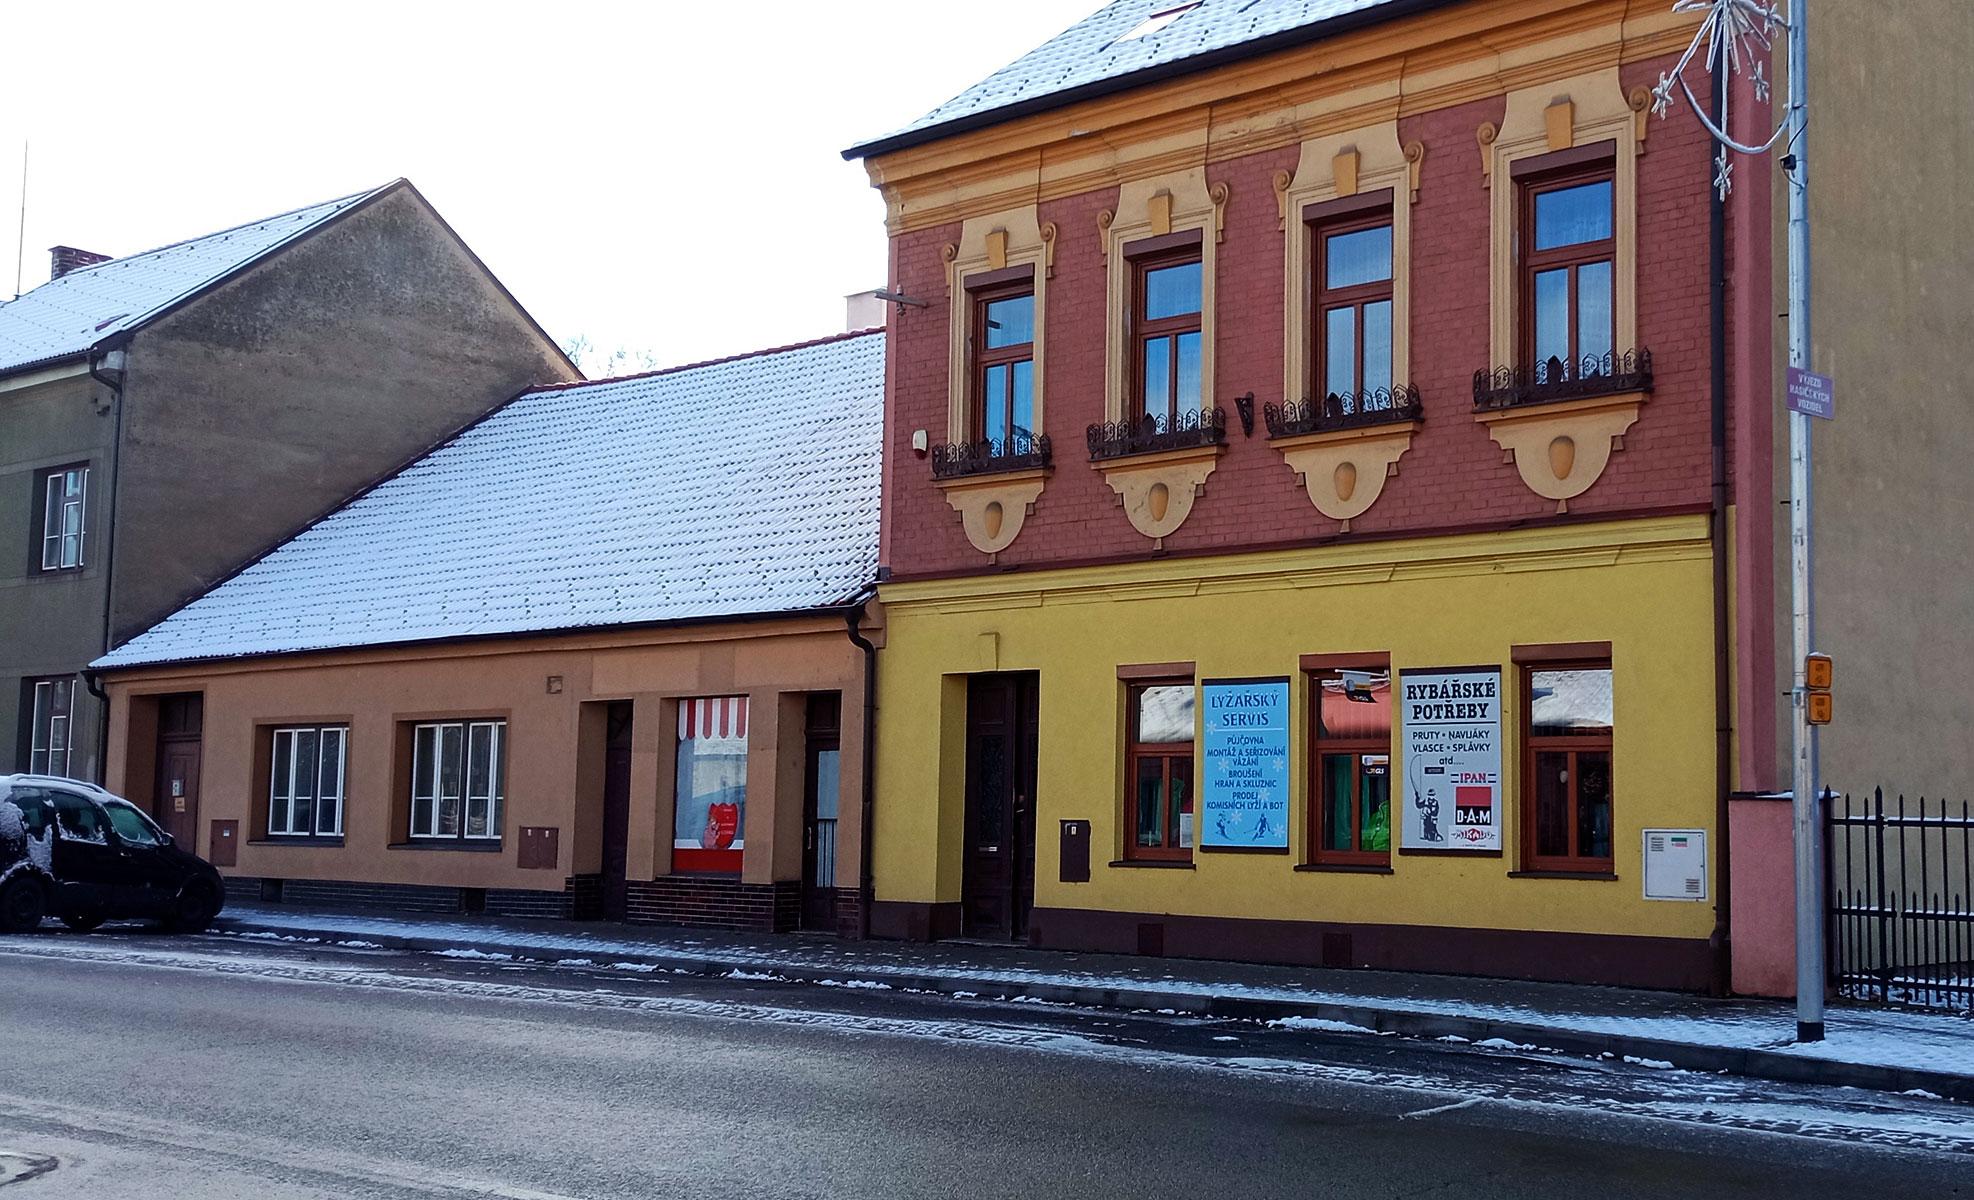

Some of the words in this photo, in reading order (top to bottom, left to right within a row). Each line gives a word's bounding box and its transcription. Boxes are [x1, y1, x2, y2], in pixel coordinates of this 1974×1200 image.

[1797, 398, 1823, 413] VOZIDEL
[1406, 678, 1496, 700] RYBÁŘSKÉ
[1211, 689, 1279, 709] LYŽAŘSKÝ
[1412, 699, 1489, 720] POTŘEBY
[1222, 712, 1269, 727] SERVIS
[1412, 731, 1440, 740] PRUTY
[1448, 727, 1490, 740] NAVIJÁKY
[1227, 735, 1264, 746] PŮJČOVNA
[1412, 743, 1444, 753] VLASCE
[1452, 740, 1491, 752] SPLÁVKY
[1206, 747, 1237, 757] MONTÁŽ
[1238, 749, 1244, 757] A
[1245, 746, 1286, 757] SEŘIZOVÁNÍ
[1232, 756, 1259, 767] VÁZÁNÍ
[1228, 768, 1263, 778] BROUŠENÍ
[1214, 779, 1235, 788] HRAN
[1236, 780, 1242, 788] A
[1243, 779, 1277, 788] SKLUZNIC
[1232, 791, 1259, 801] PRODEJ
[1206, 799, 1245, 810] KOMISNÍCH
[1247, 799, 1261, 811] LYŽÍ
[1262, 802, 1268, 810] A
[1269, 801, 1284, 810] BOT
